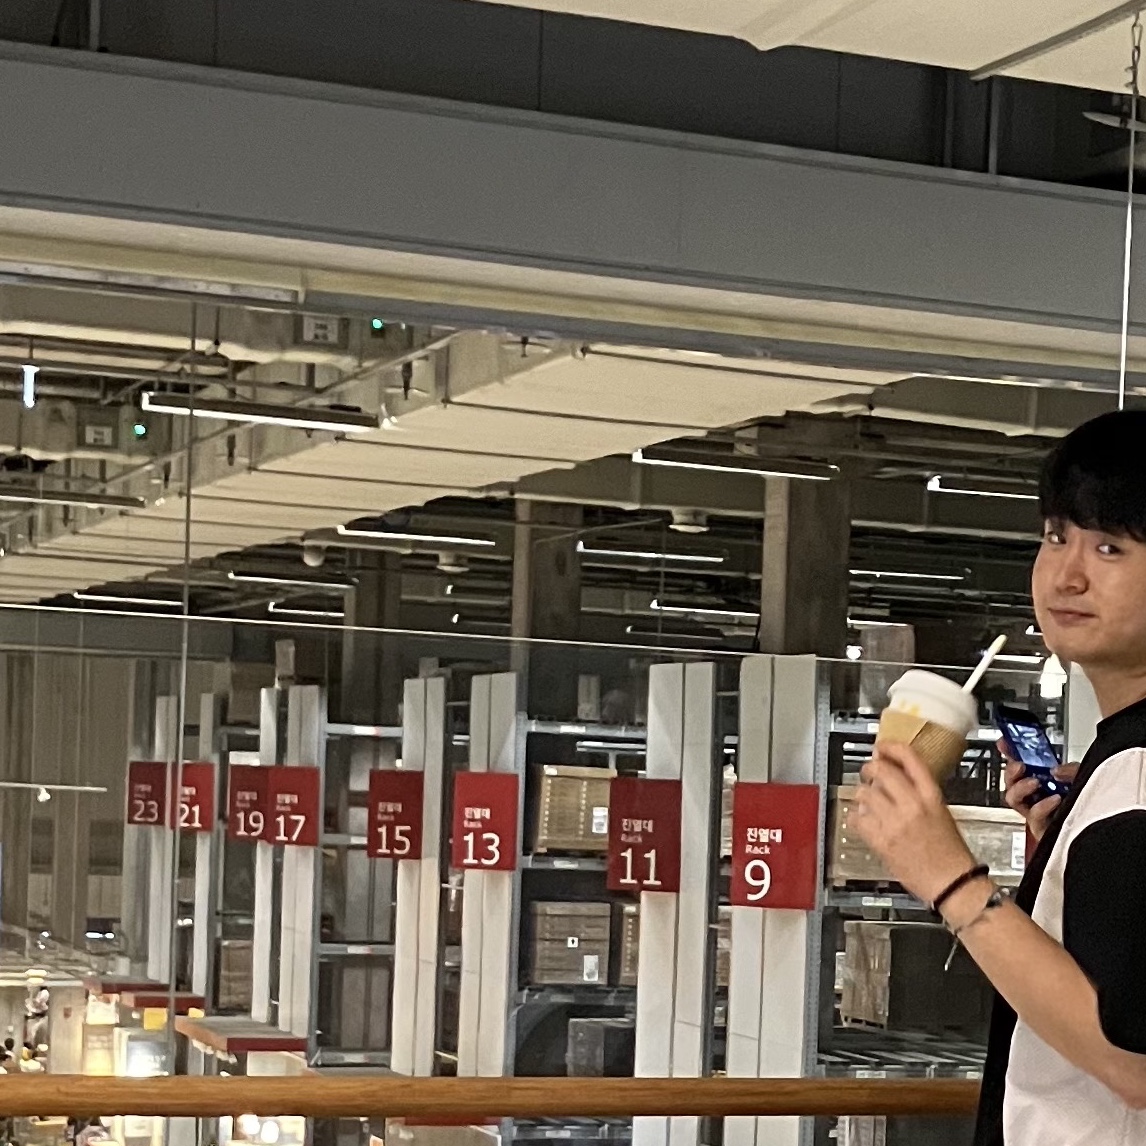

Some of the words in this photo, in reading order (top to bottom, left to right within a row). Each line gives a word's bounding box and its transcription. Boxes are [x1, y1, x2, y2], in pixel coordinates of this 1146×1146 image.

[132, 799, 159, 823] 23
[179, 803, 203, 828] 21
[235, 810, 265, 837] 19
[275, 814, 306, 841] 17
[376, 824, 412, 855] 15
[746, 827, 783, 843] 진열대
[462, 831, 501, 866] 13
[745, 844, 771, 855] Rack
[619, 847, 662, 886] 11
[743, 859, 772, 902] 9
